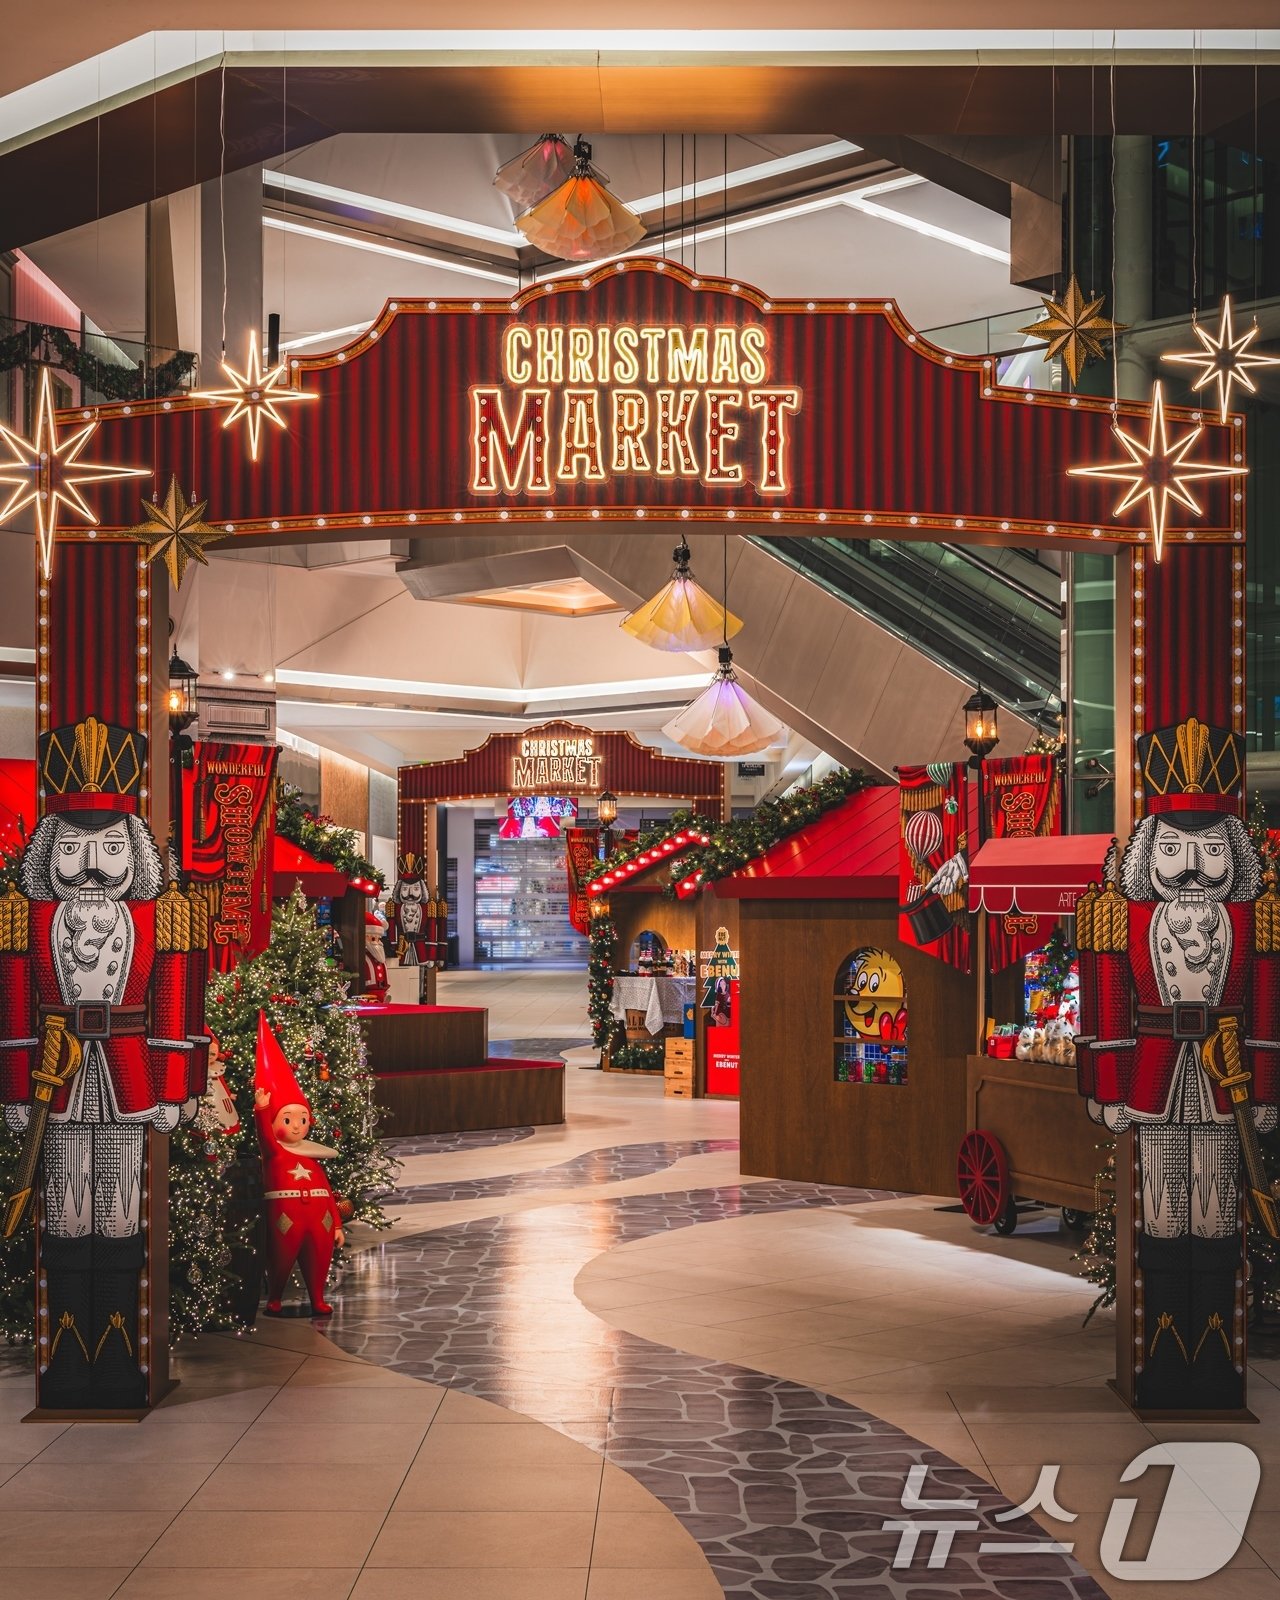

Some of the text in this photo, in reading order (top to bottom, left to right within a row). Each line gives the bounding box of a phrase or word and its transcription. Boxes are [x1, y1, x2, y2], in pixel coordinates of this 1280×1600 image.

[506, 326, 766, 384] CHRISTMAS
[472, 388, 798, 491] MARKET
[521, 739, 593, 757] CHRISTMAS
[206, 760, 266, 777] WONDERFUL
[513, 756, 601, 787] MARKET
[994, 771, 1047, 786] WONDERFUL
[214, 783, 254, 945] SHOWTIME
[1058, 892, 1077, 908] ARTE
[716, 1061, 739, 1069] EBENUT
